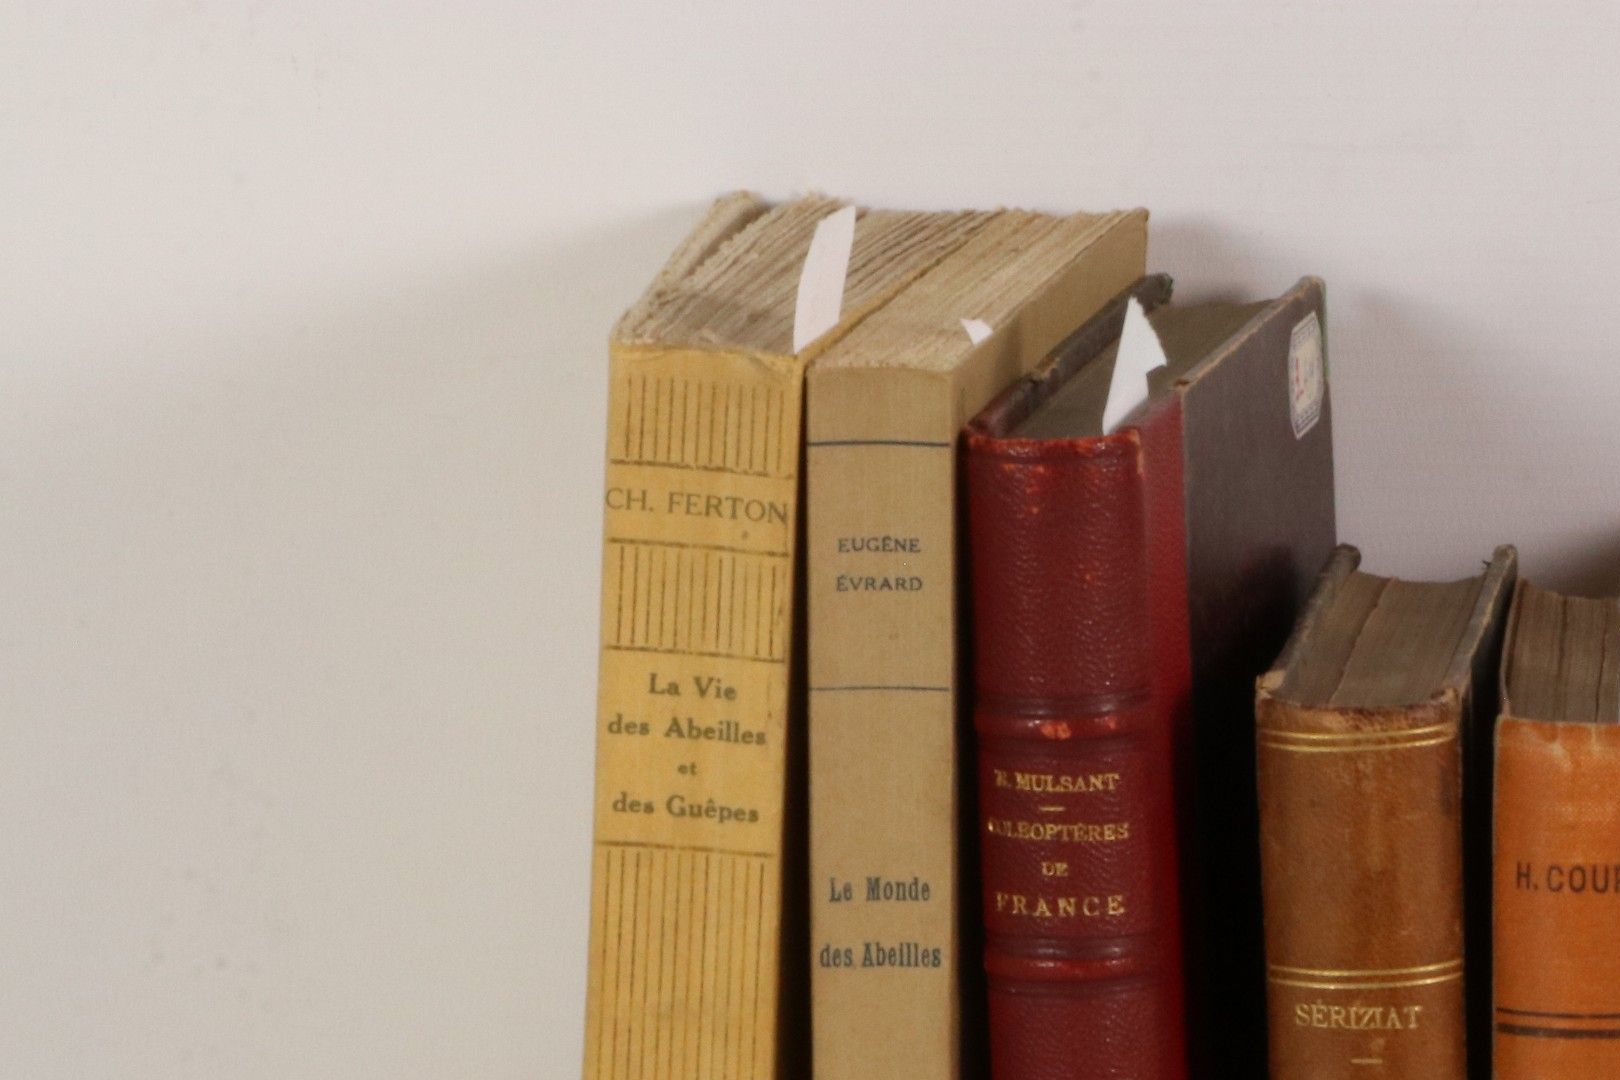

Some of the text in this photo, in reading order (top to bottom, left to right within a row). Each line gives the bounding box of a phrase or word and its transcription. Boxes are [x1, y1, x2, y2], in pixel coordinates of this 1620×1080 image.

[605, 487, 788, 526] CH. FERTON
[835, 574, 923, 593] ÉVRARD
[648, 673, 737, 702] La Vie
[608, 714, 766, 746] des Abeilles
[677, 760, 697, 776] et
[1015, 772, 1120, 792] MULSANT
[612, 792, 759, 824] des Guêpes
[1516, 861, 1538, 891] H.
[829, 877, 930, 902] Le Monde
[997, 892, 1125, 917] FRANCE
[820, 943, 941, 968] des Abeilles
